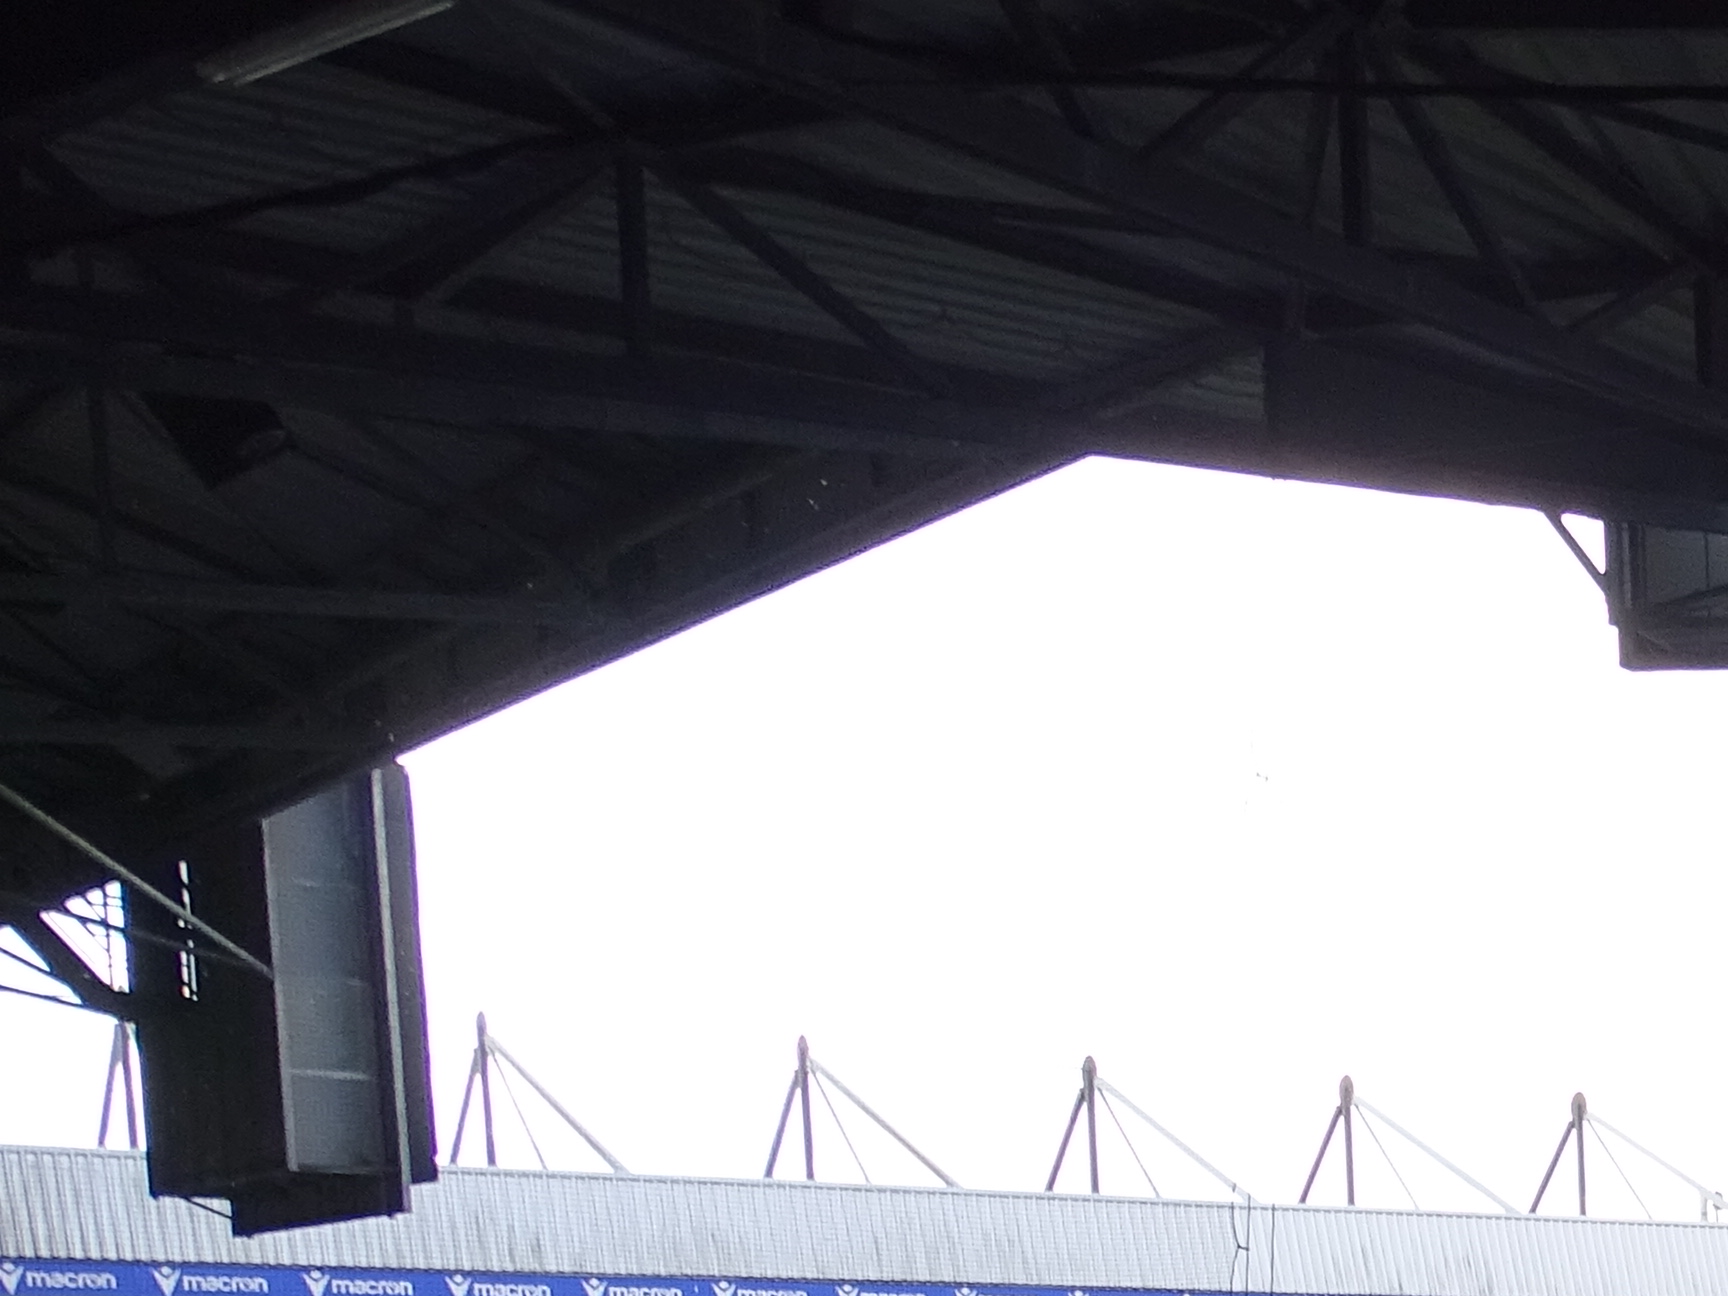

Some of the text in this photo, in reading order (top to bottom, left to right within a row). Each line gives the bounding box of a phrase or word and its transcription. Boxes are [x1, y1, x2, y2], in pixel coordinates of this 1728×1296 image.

[26, 1270, 116, 1290] macron
[183, 1274, 268, 1294] macron
[332, 1278, 414, 1296] macron
